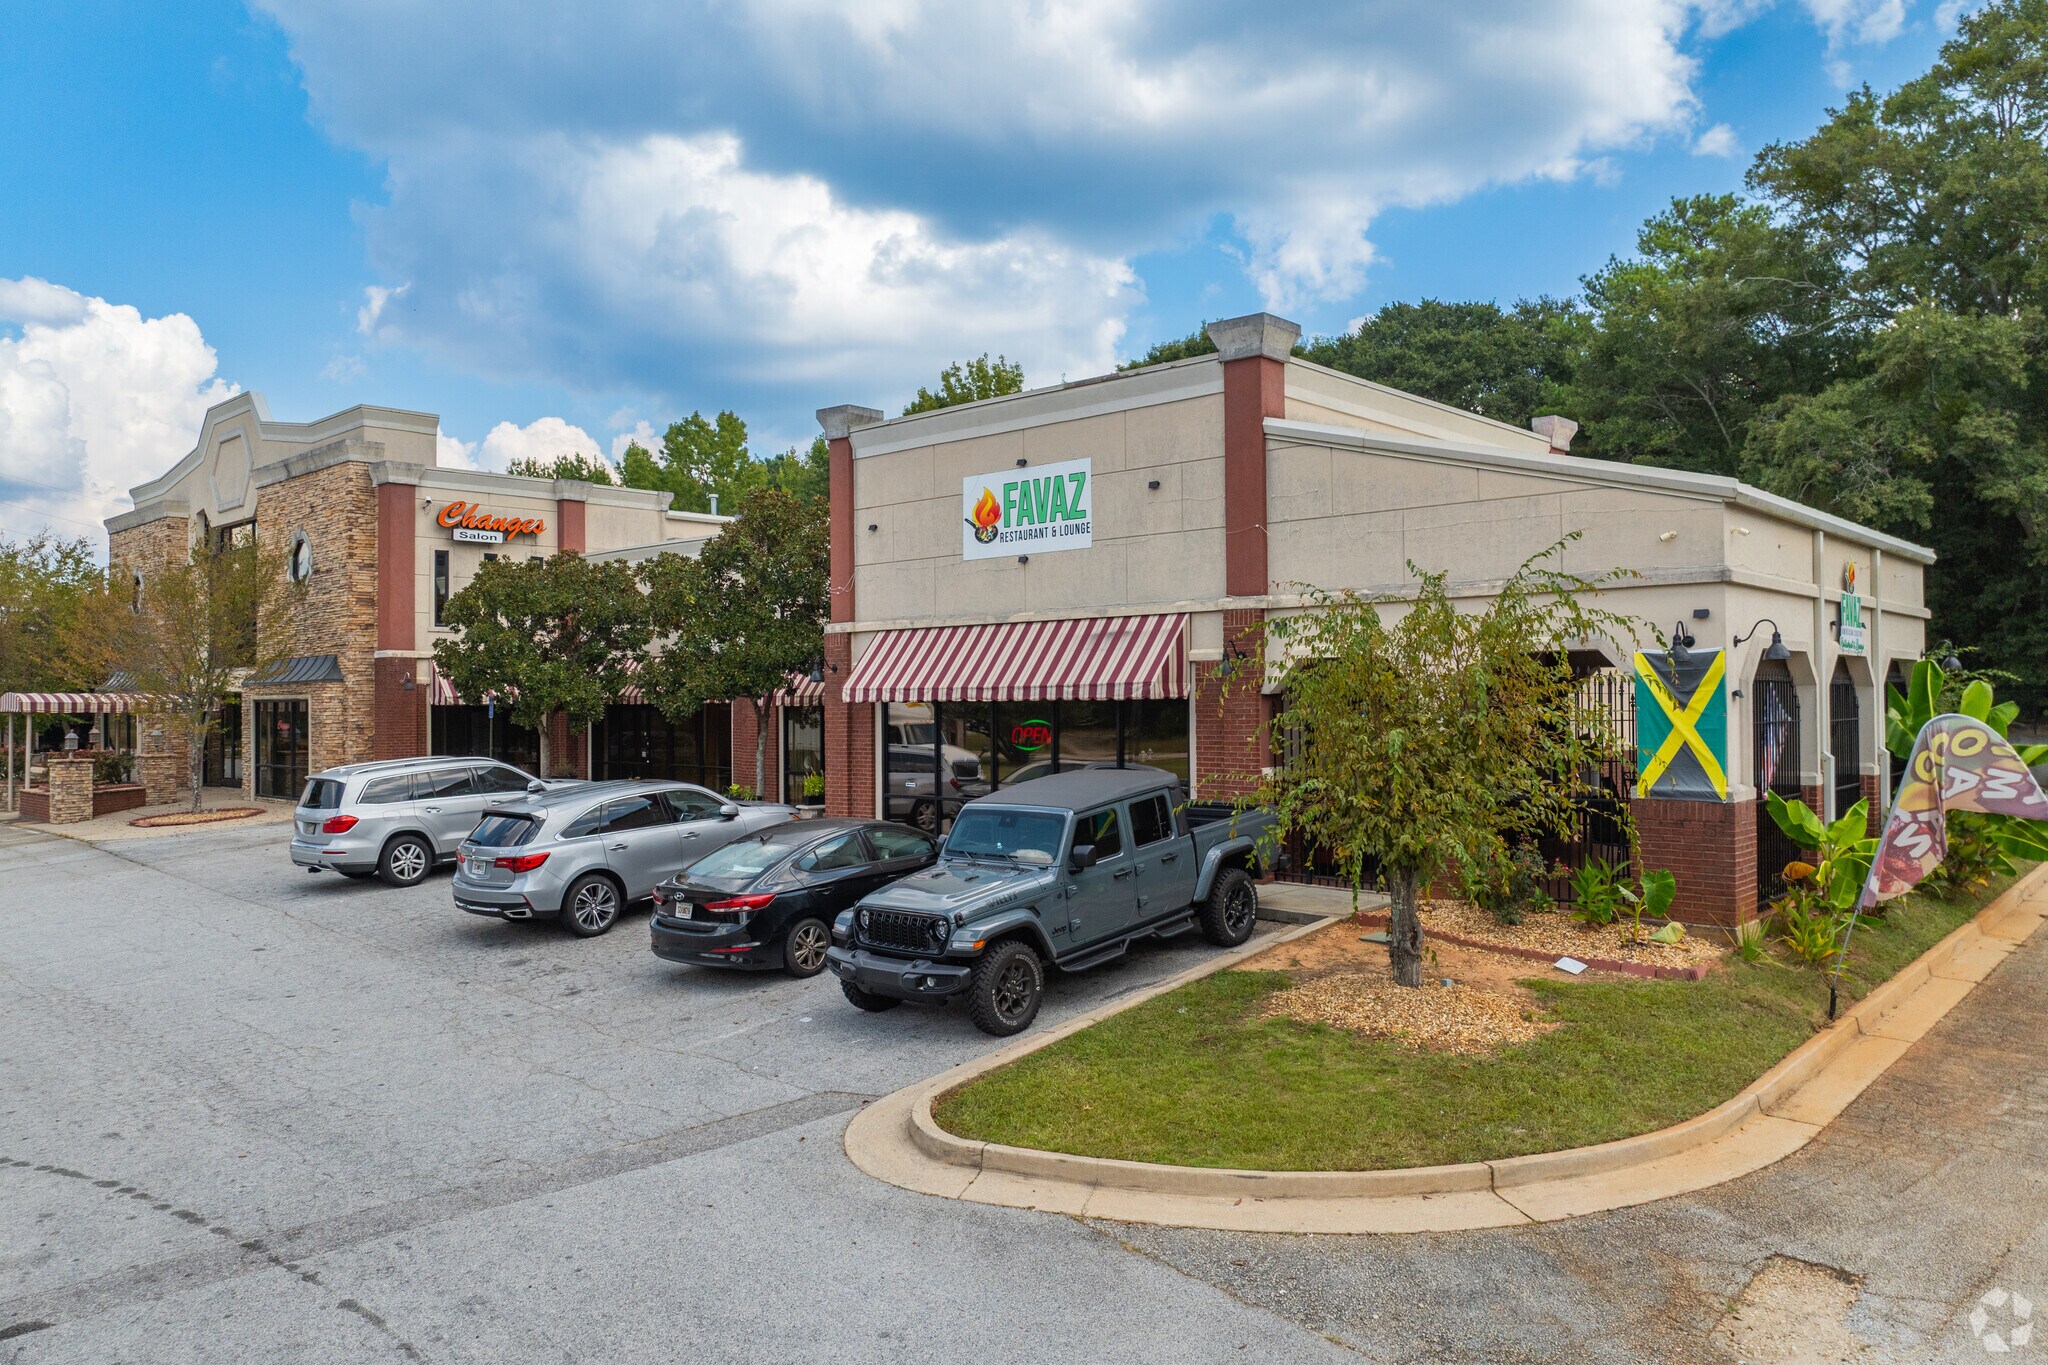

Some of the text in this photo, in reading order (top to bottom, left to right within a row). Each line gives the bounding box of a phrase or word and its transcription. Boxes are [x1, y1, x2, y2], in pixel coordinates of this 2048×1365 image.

[1003, 471, 1087, 528] FAVAZ
[437, 500, 547, 541] Changes
[1000, 522, 1091, 543] RESTAURANT & LOUNGE
[459, 531, 498, 541] Salon
[1841, 593, 1861, 628] FAVAZ
[1011, 726, 1052, 745] OPEN
